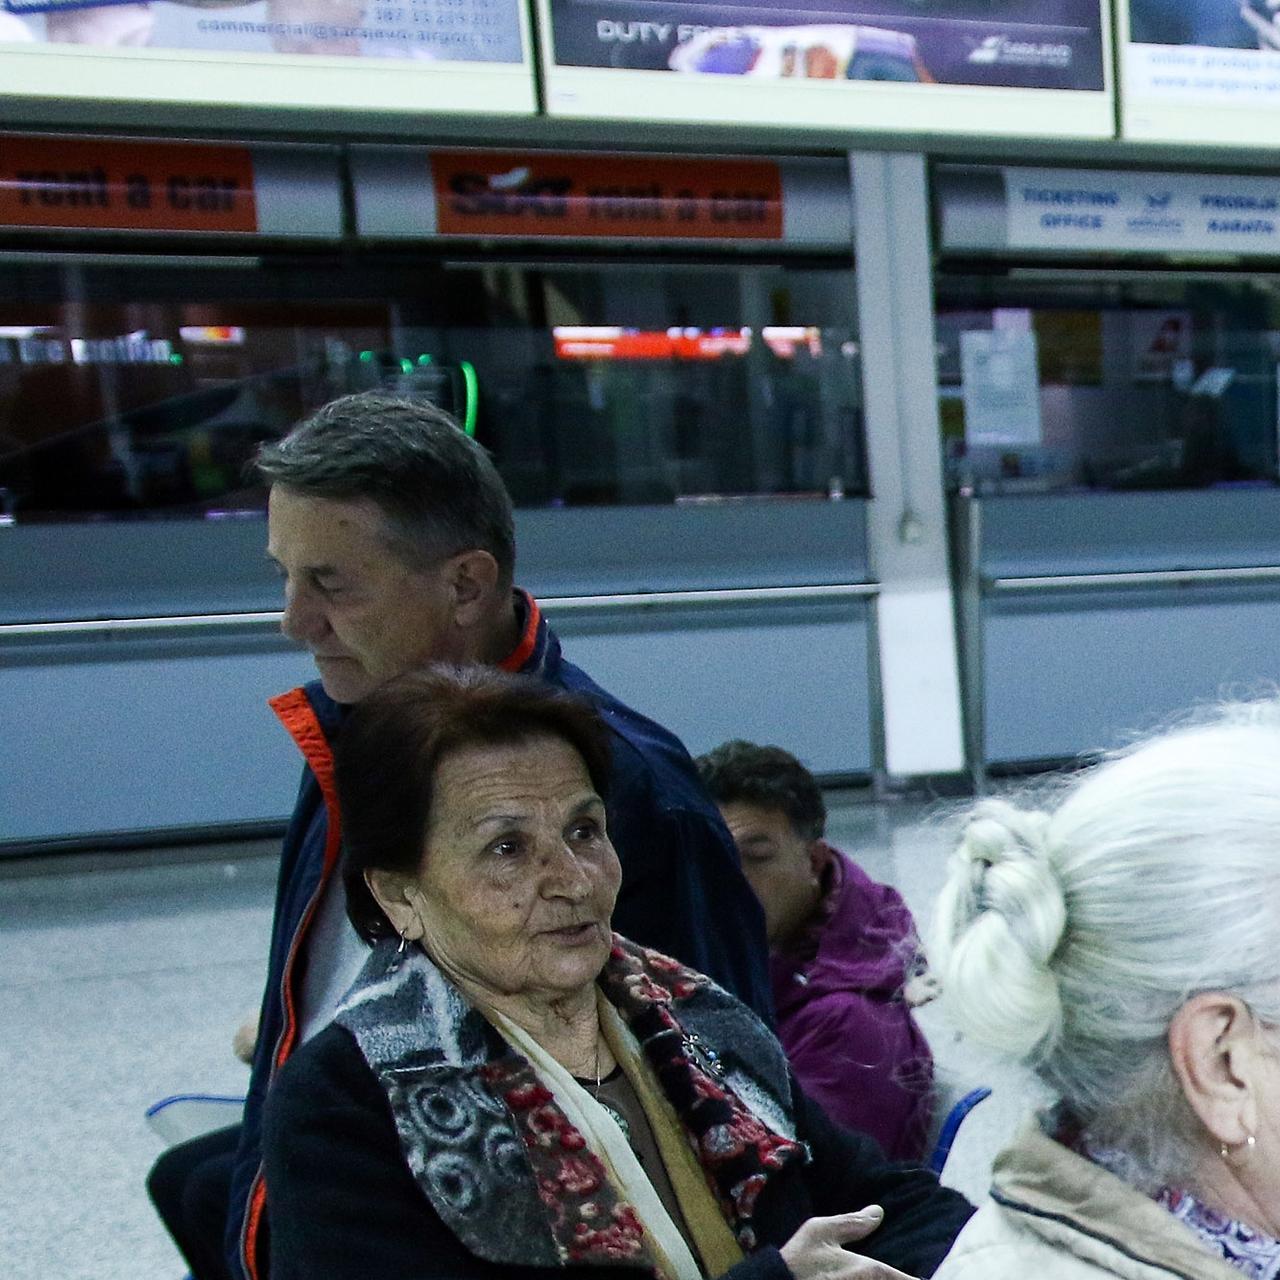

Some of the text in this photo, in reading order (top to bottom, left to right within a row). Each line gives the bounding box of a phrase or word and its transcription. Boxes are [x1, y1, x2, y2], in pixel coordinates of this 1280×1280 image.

[596, 20, 669, 44] DUTY
[16, 168, 238, 211] rent a car
